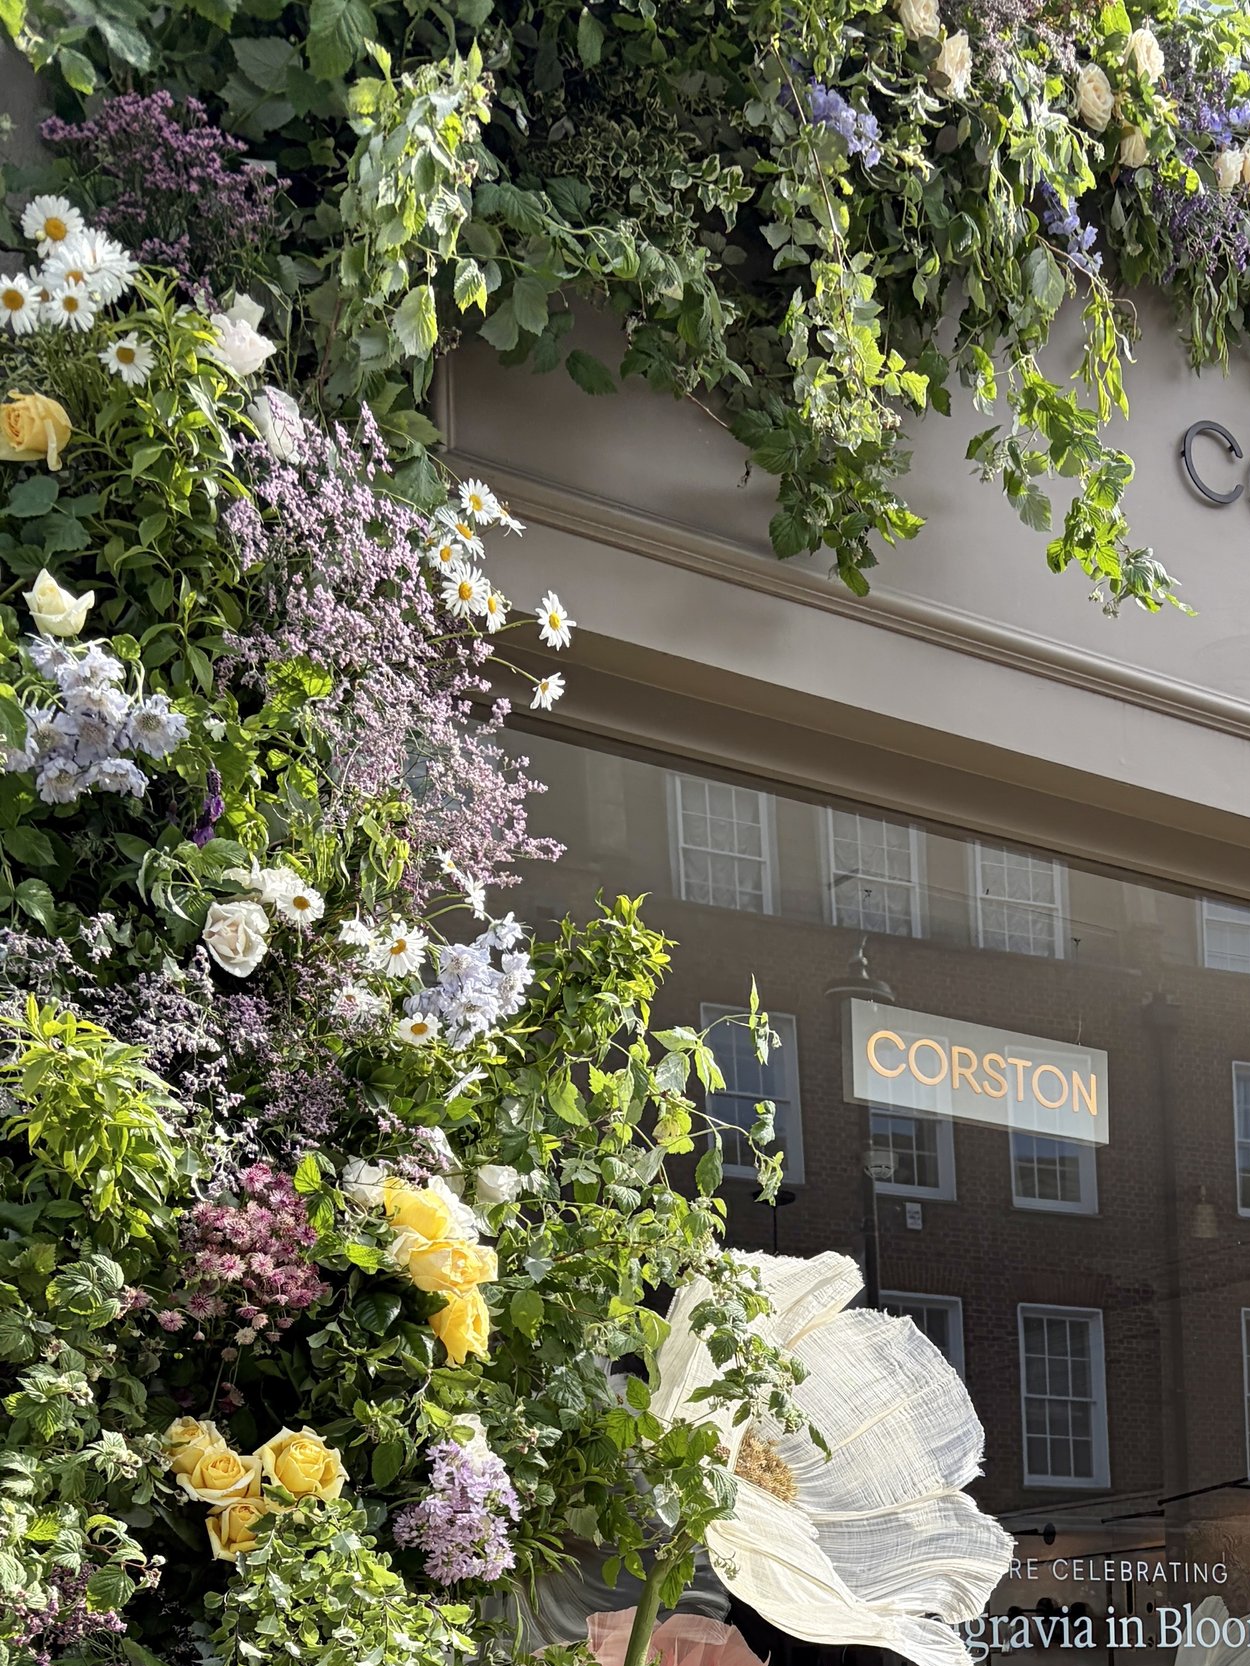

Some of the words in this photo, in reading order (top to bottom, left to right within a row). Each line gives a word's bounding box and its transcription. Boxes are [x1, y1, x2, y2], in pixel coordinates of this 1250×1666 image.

[866, 1029, 1098, 1117] CORSTON
[1052, 1558, 1228, 1584] CELEBRATING
[931, 1605, 1097, 1662] gravia
[1106, 1605, 1147, 1648] in
